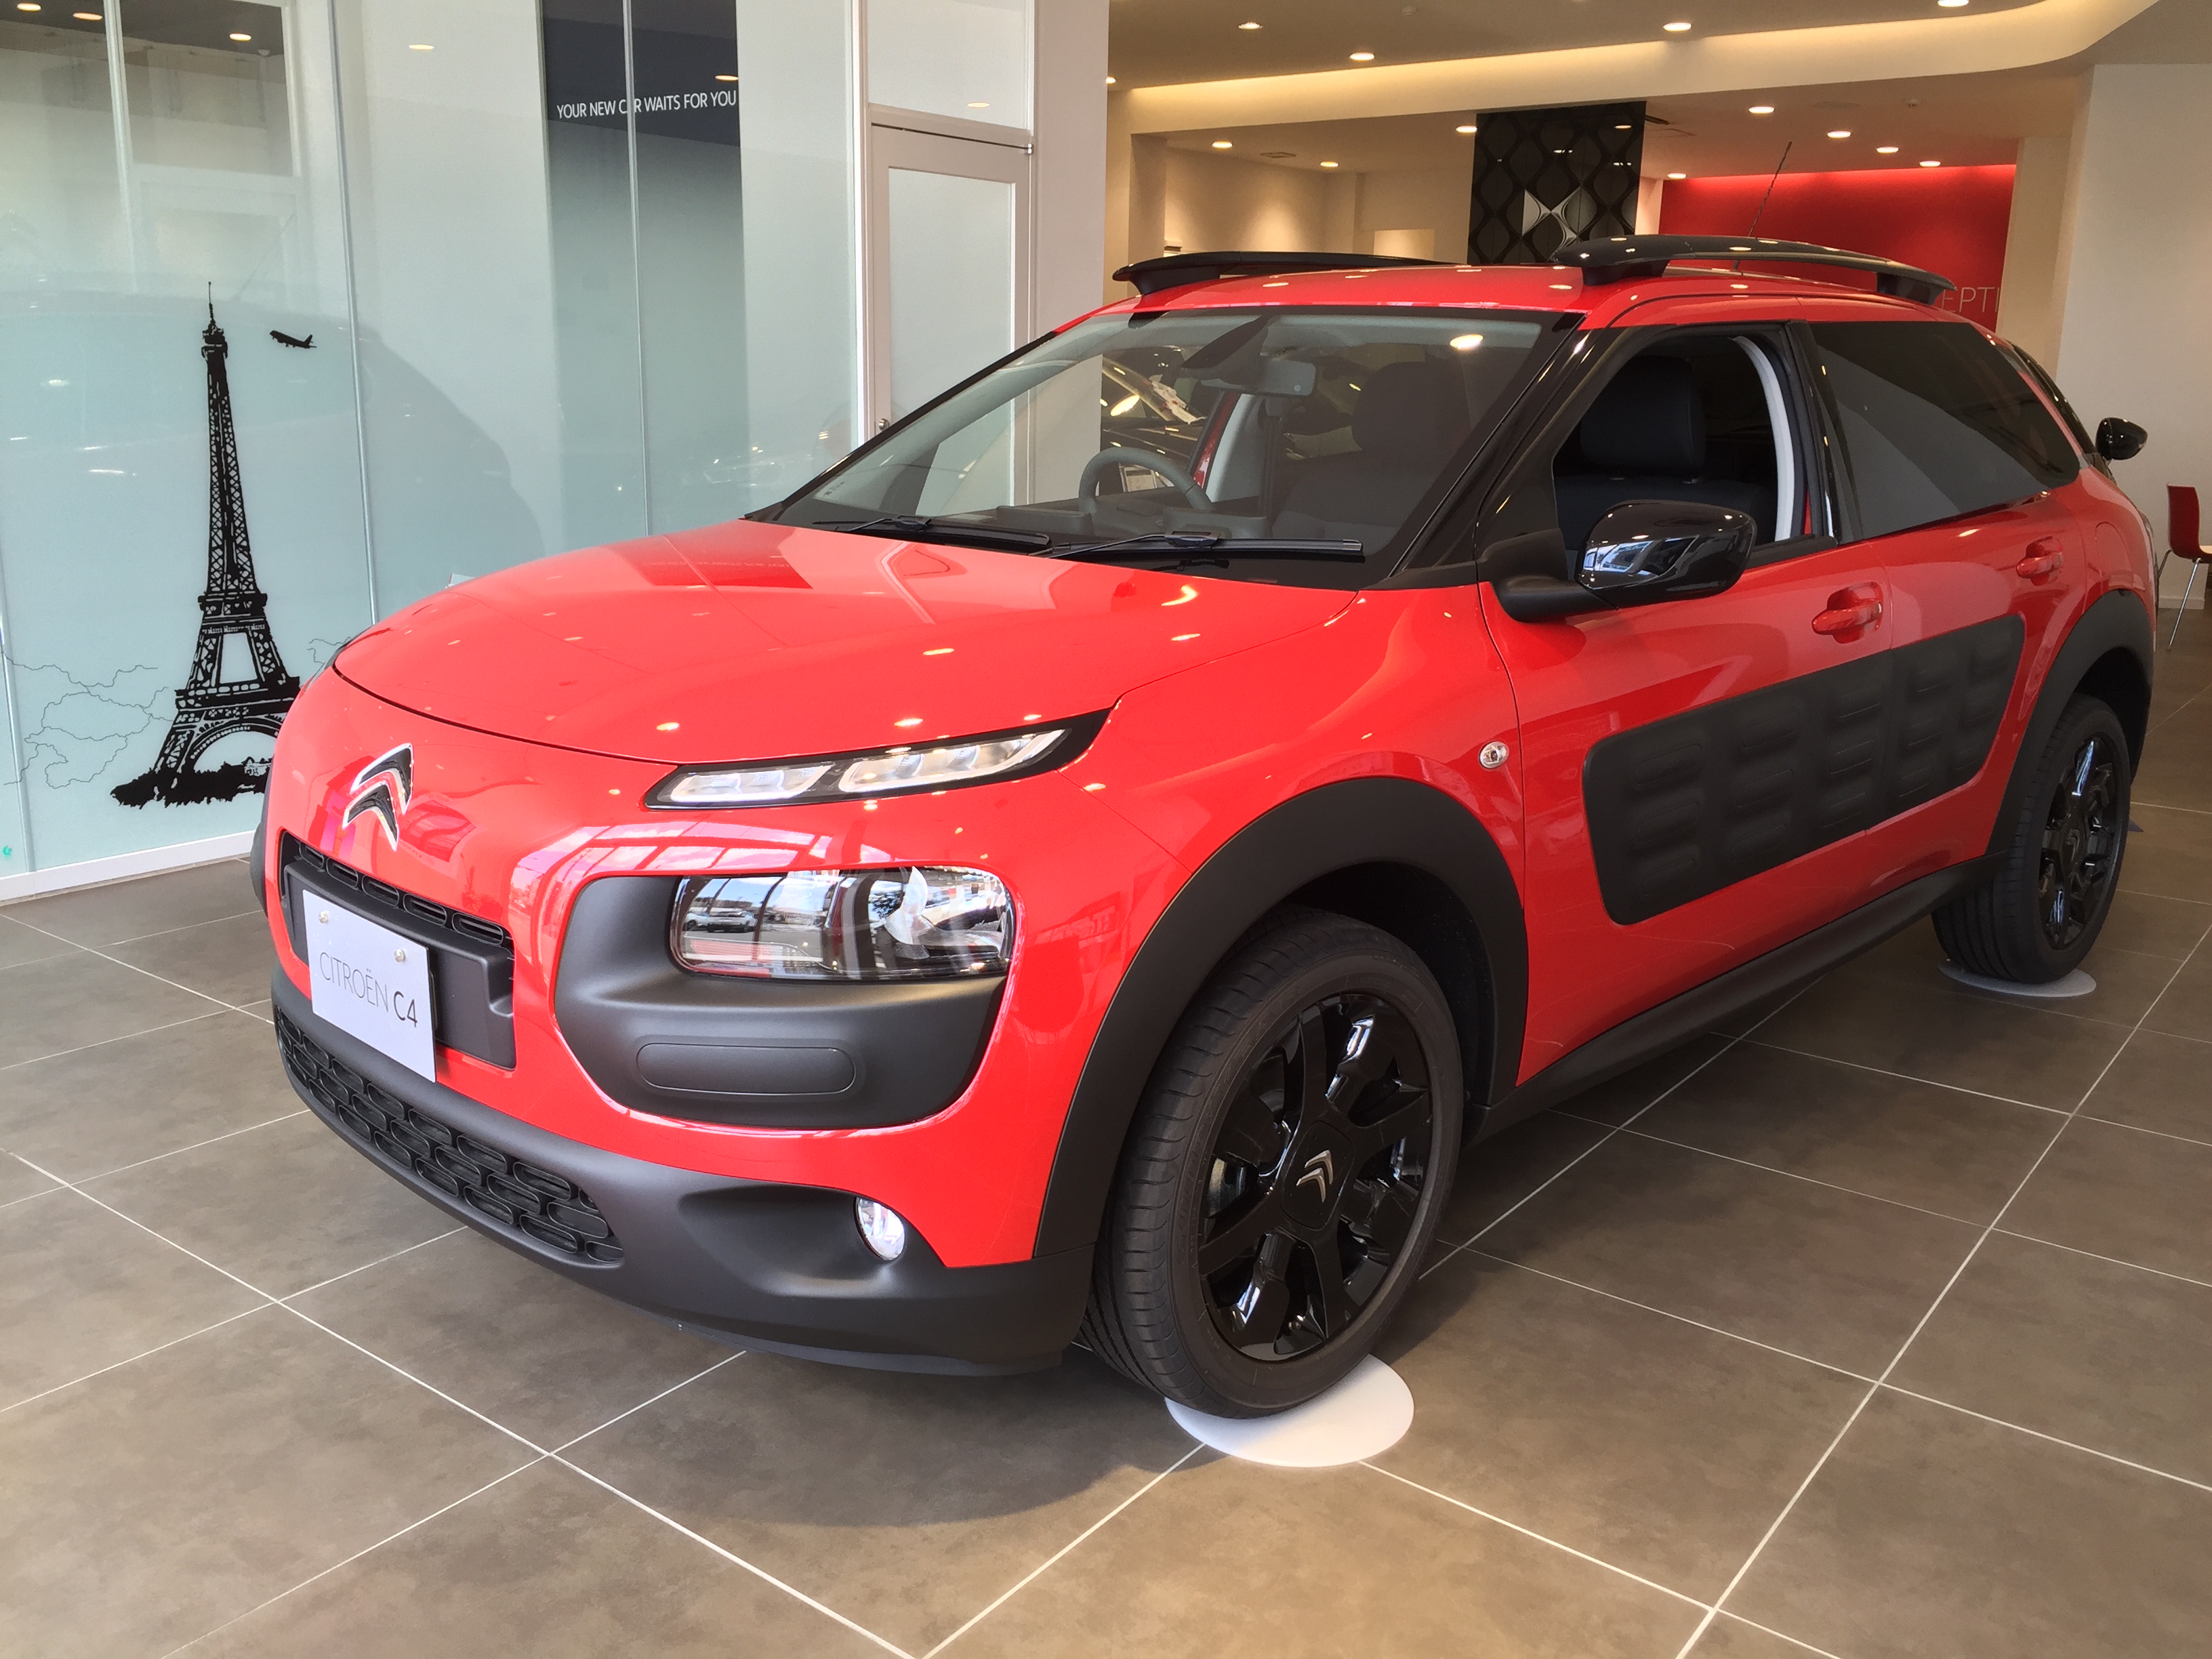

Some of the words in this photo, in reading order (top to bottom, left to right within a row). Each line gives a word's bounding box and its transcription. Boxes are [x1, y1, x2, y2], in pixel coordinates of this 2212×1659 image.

[556, 102, 587, 119] YOUR
[590, 100, 616, 116] NEW
[618, 98, 642, 114] CR
[643, 94, 680, 112] WAITS
[684, 92, 708, 109] FOR
[710, 89, 737, 106] YOU
[319, 951, 389, 1012] CITROËN
[393, 991, 418, 1027] C4
